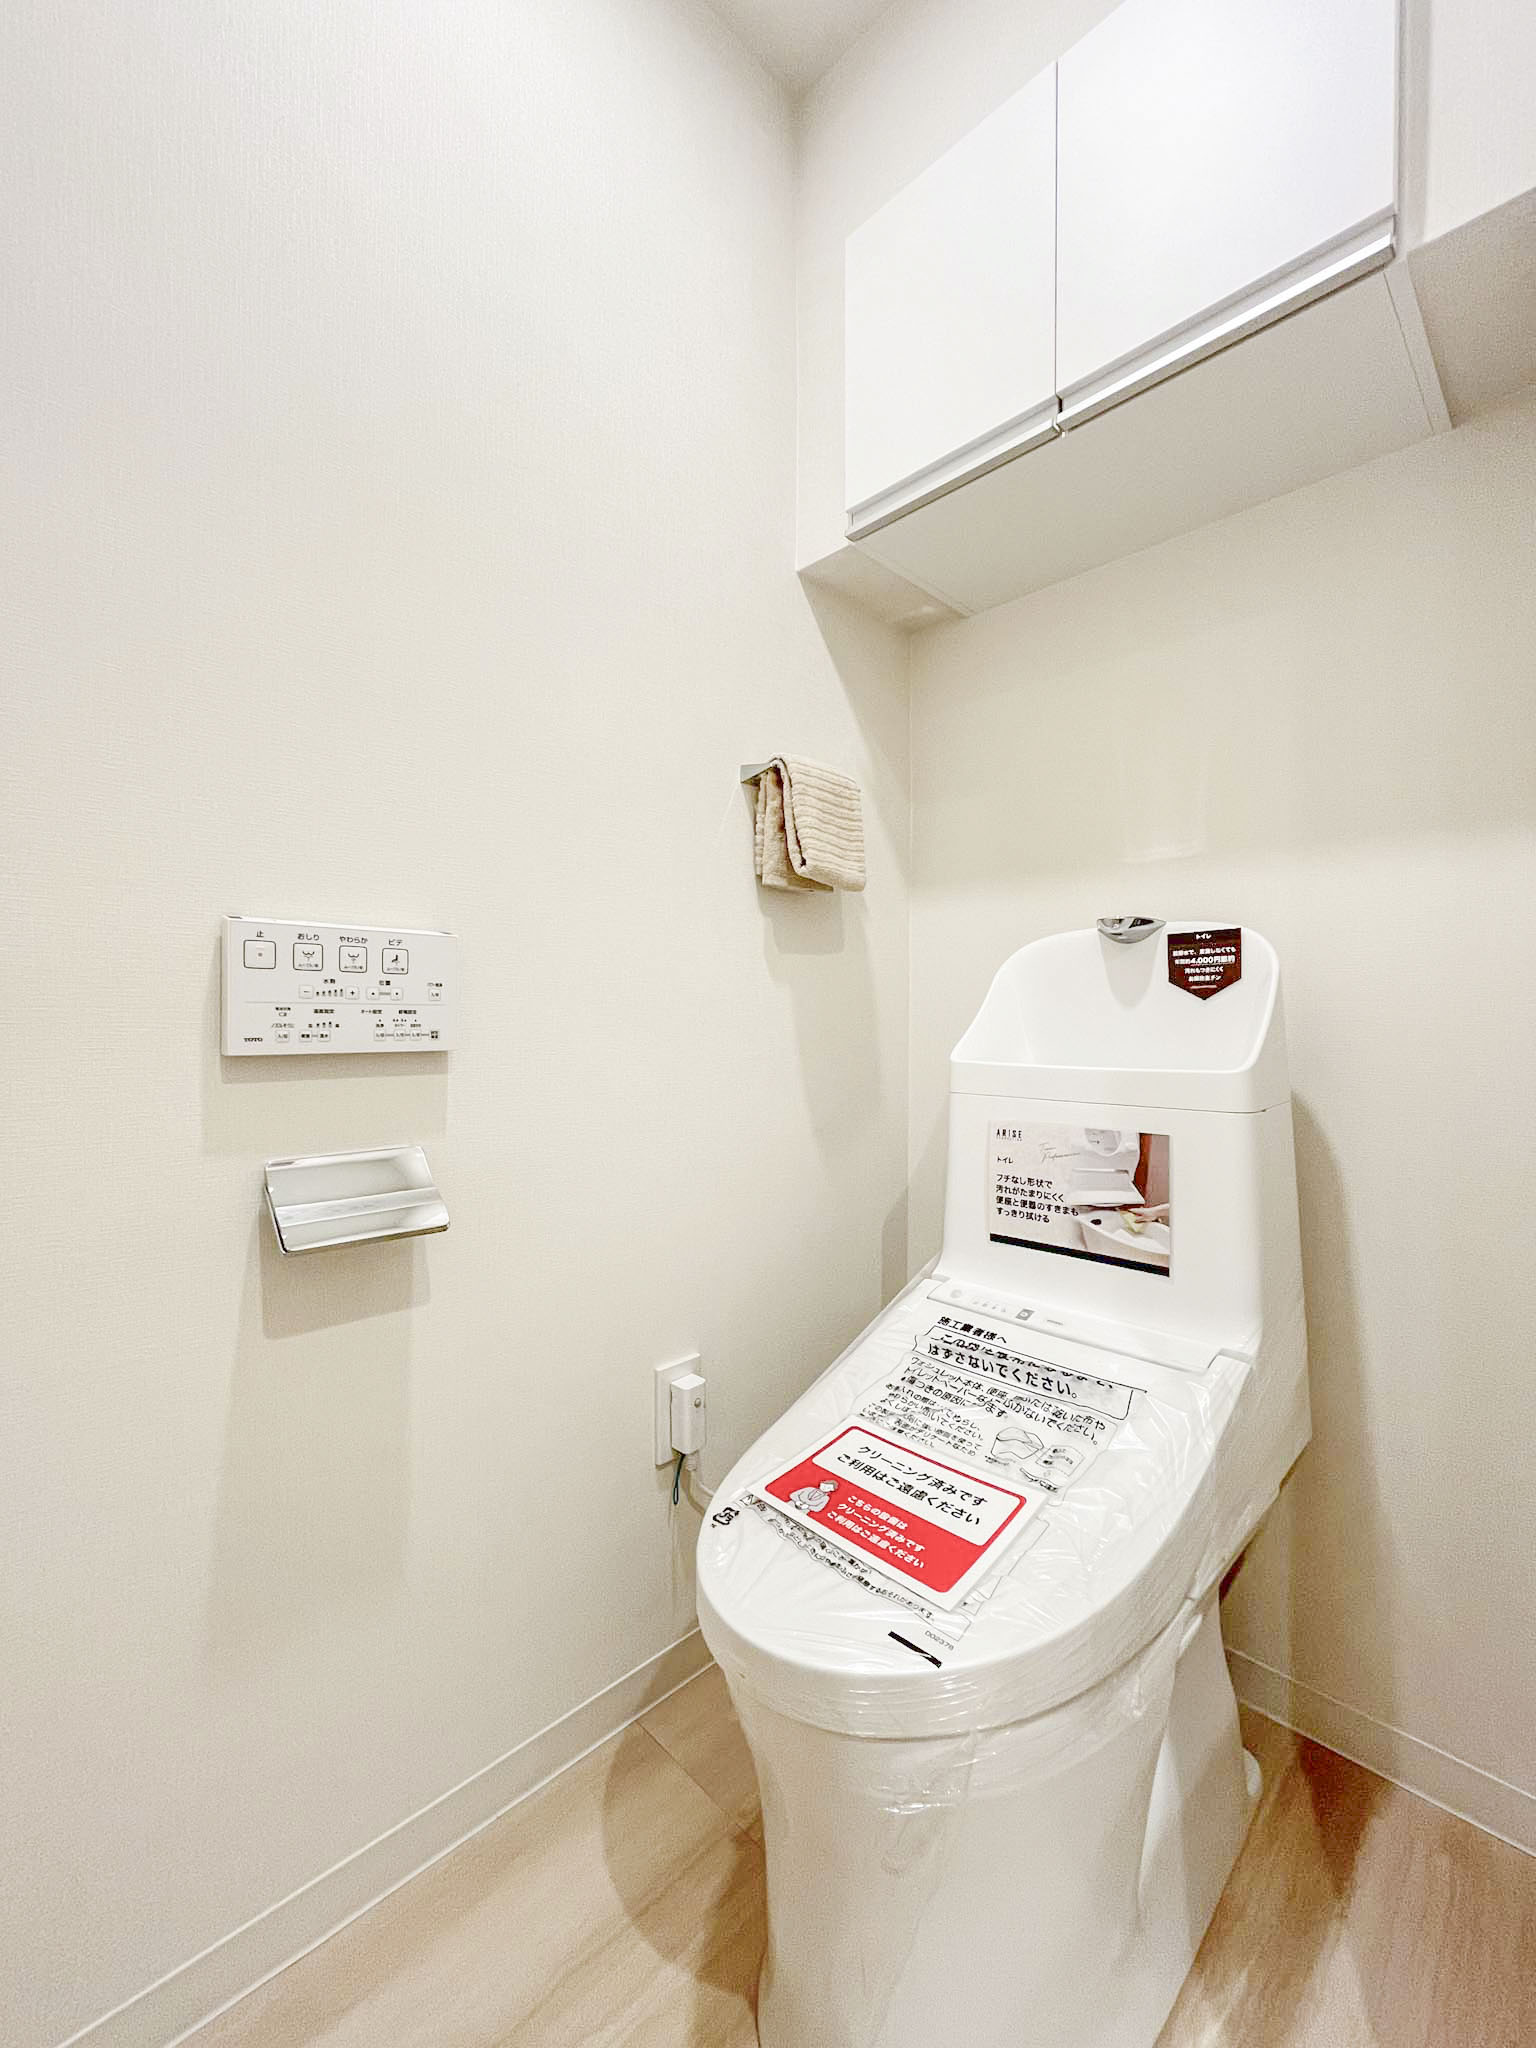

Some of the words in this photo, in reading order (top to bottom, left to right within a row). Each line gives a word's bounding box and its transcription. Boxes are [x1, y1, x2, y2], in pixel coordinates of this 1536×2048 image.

[297, 933, 320, 941] おしり
[339, 936, 368, 944] やわらか
[996, 1128, 1022, 1138] ARISE
[997, 1156, 1014, 1164] トイレ
[996, 1173, 1053, 1189] フチなし形状で
[995, 1184, 1065, 1203] 汚れがたまりにくく
[995, 1195, 1079, 1216] 便座と便器のすきまも
[996, 1207, 1050, 1223] すっきり拭ける
[937, 1316, 1007, 1343] 施工業者様へ
[928, 1343, 1078, 1398] はずさないでください。
[858, 1446, 989, 1507] クリーニング済みです
[837, 1453, 981, 1526] ご利用はご遠慮ください
[837, 1503, 926, 1552] クリーニング済みです
[827, 1511, 924, 1568] ご利用はご遠慮ください
